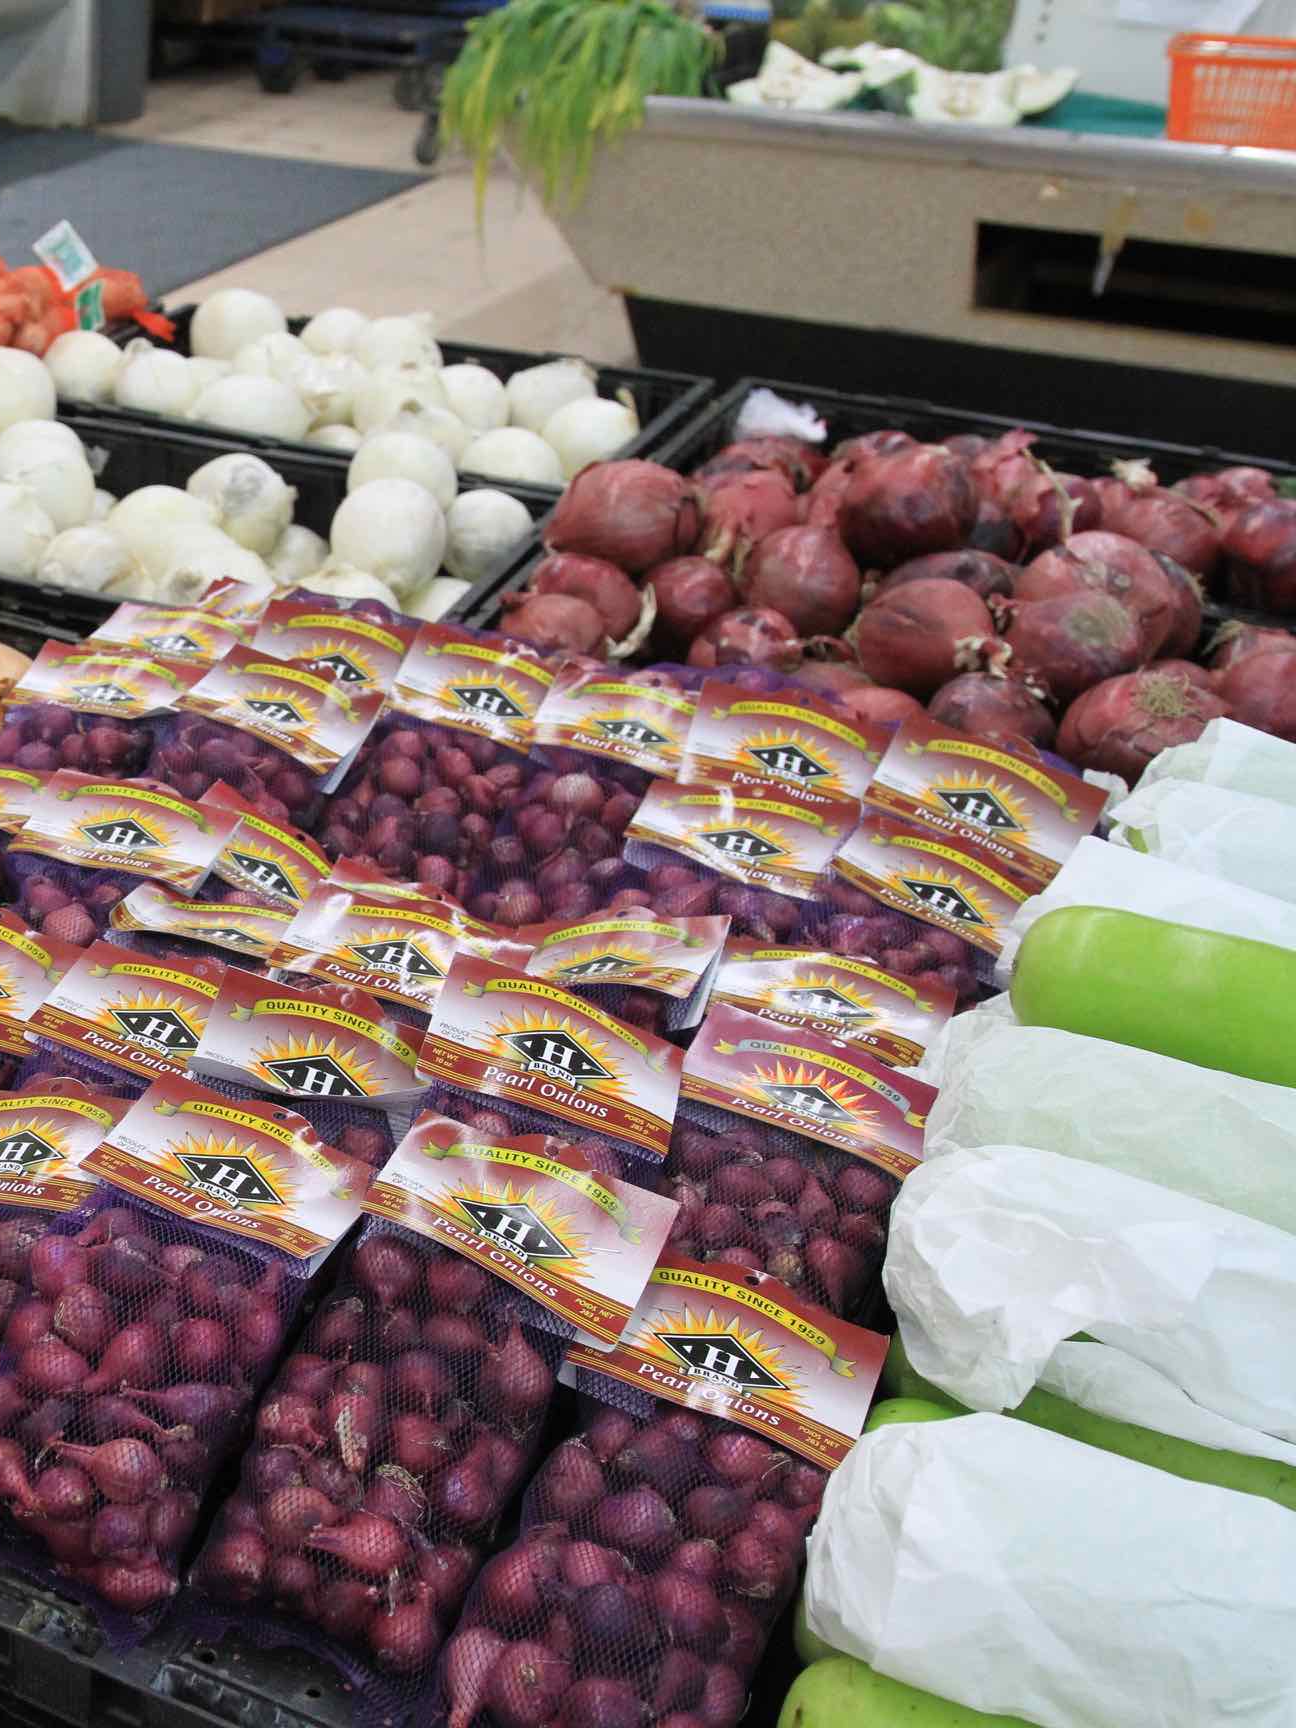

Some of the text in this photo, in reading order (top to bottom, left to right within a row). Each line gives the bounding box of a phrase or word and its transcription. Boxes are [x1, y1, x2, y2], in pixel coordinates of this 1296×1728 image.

[259, 703, 289, 722] H
[476, 691, 504, 711] H
[618, 724, 648, 740] H
[776, 751, 803, 772] H
[963, 798, 992, 820] H
[108, 827, 137, 846] H
[724, 835, 753, 854] H
[914, 807, 1014, 859] Pearl Onions
[57, 844, 153, 869] Pearl Onions
[252, 865, 281, 887] H
[880, 887, 921, 914] Pearl
[929, 889, 959, 911] H
[352, 906, 451, 931] QUALITY SINCE
[20, 939, 48, 961] 1959
[381, 947, 416, 967] H
[123, 965, 181, 980] QUALITY
[325, 964, 372, 986] Pearl
[497, 981, 640, 1048] QUALITY SINCE 1959
[757, 1008, 806, 1027] Pearl
[138, 1016, 179, 1044] H
[266, 1001, 410, 1058] QUALITY SINCE 1959
[82, 1031, 130, 1055] Pearl
[131, 1034, 166, 1053] BRAND
[539, 1038, 580, 1071] H
[303, 1065, 340, 1096] H
[534, 1061, 574, 1085] BRAND
[749, 1041, 903, 1102] QUALITY SINCE 1959
[483, 1066, 609, 1118] Pearl Onions
[792, 1092, 828, 1112] H
[39, 1098, 75, 1108] SINCE
[78, 1103, 106, 1120] 1959
[194, 1103, 257, 1126] QUALITY
[731, 1097, 858, 1145] Pearl Onions
[208, 1163, 253, 1194] H
[535, 1159, 586, 1183] SINCE
[585, 1184, 619, 1212] 1959
[143, 1176, 263, 1229] Pearl Onions
[198, 1182, 236, 1204] BRAND
[492, 1213, 535, 1244] H
[484, 1231, 525, 1258] BRAND
[432, 1216, 560, 1298] Pearl Onions
[659, 1271, 826, 1347] QUALITY SINCE 1959
[700, 1344, 744, 1377] H
[693, 1366, 739, 1389] BRAND
[638, 1363, 782, 1426] Pearl Onions
